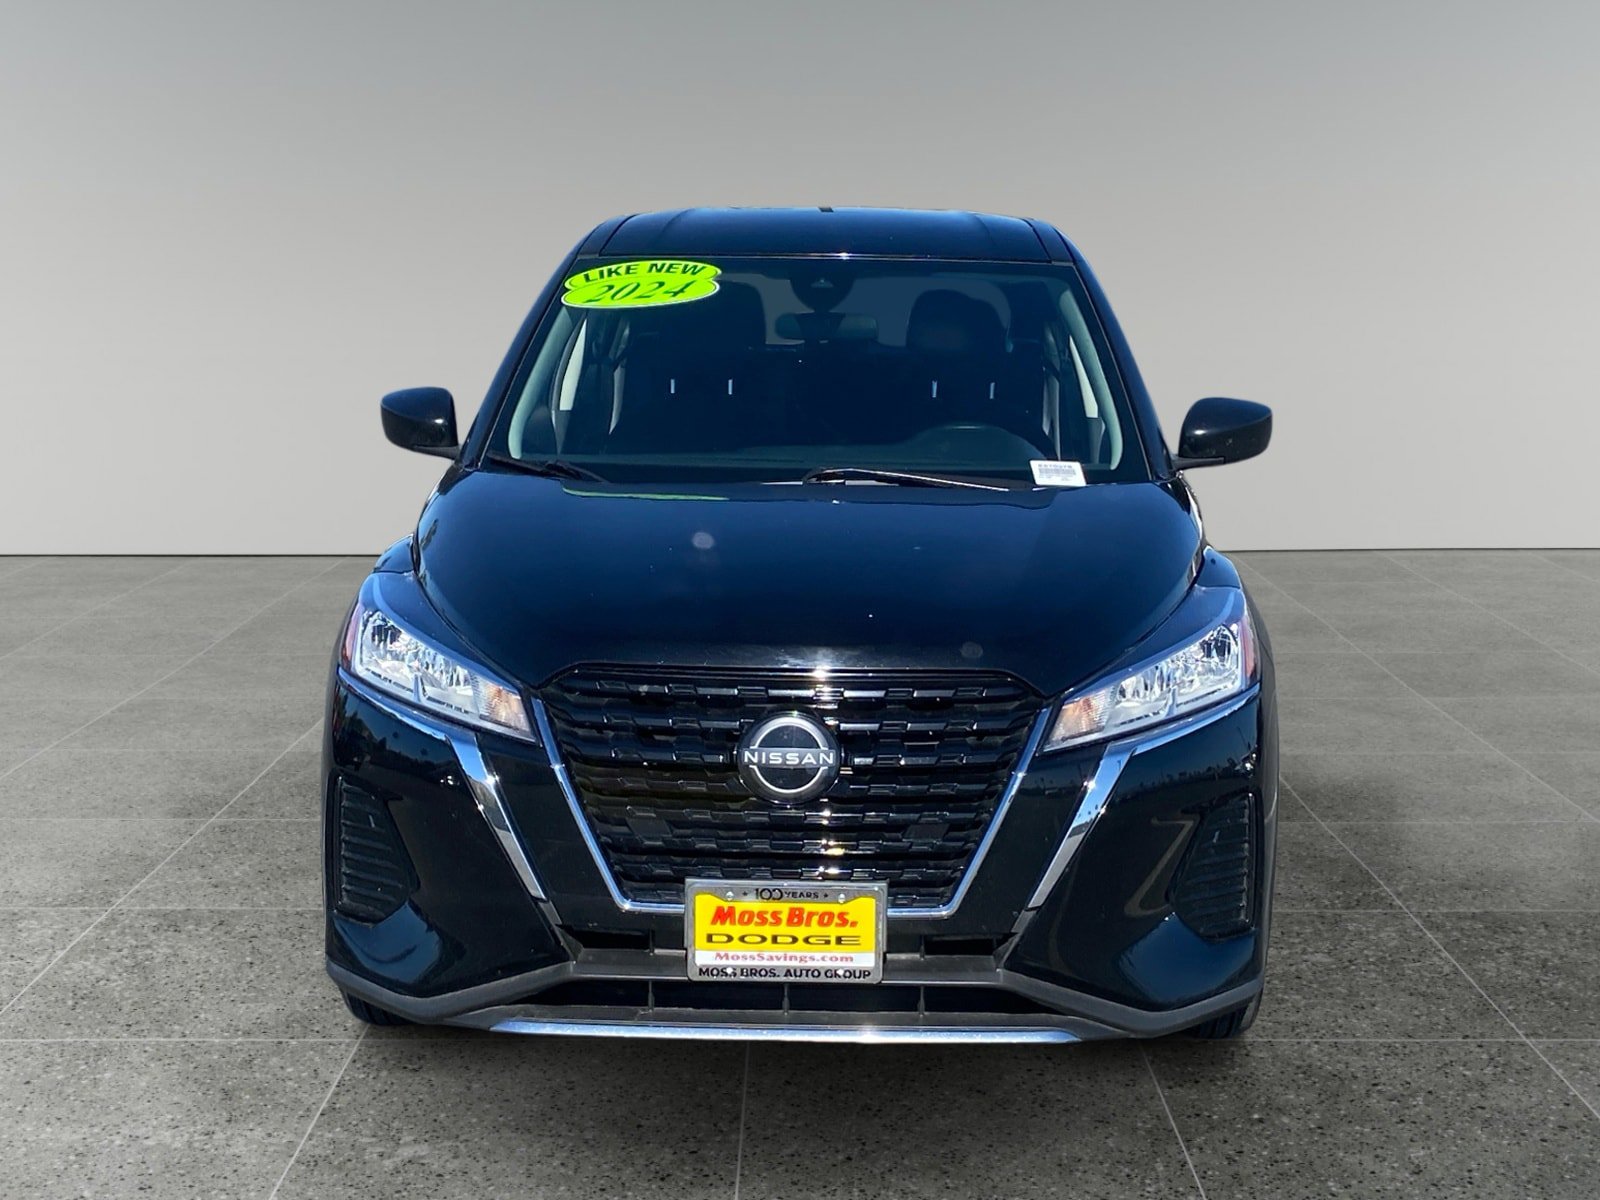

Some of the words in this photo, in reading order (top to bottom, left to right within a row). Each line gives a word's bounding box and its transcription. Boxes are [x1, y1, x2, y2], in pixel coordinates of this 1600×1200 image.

[583, 263, 640, 283] LIKE
[647, 262, 706, 276] NEW
[582, 280, 697, 303] 2024
[744, 751, 833, 765] NISSAN
[755, 887, 783, 901] 100
[784, 891, 820, 899] YEARS
[710, 905, 783, 927] Moss
[785, 906, 858, 928] Bros.
[706, 933, 861, 946] DODGE
[714, 952, 854, 963] MossSavings.com
[740, 968, 780, 978] BROS.
[783, 968, 821, 979] AUTO
